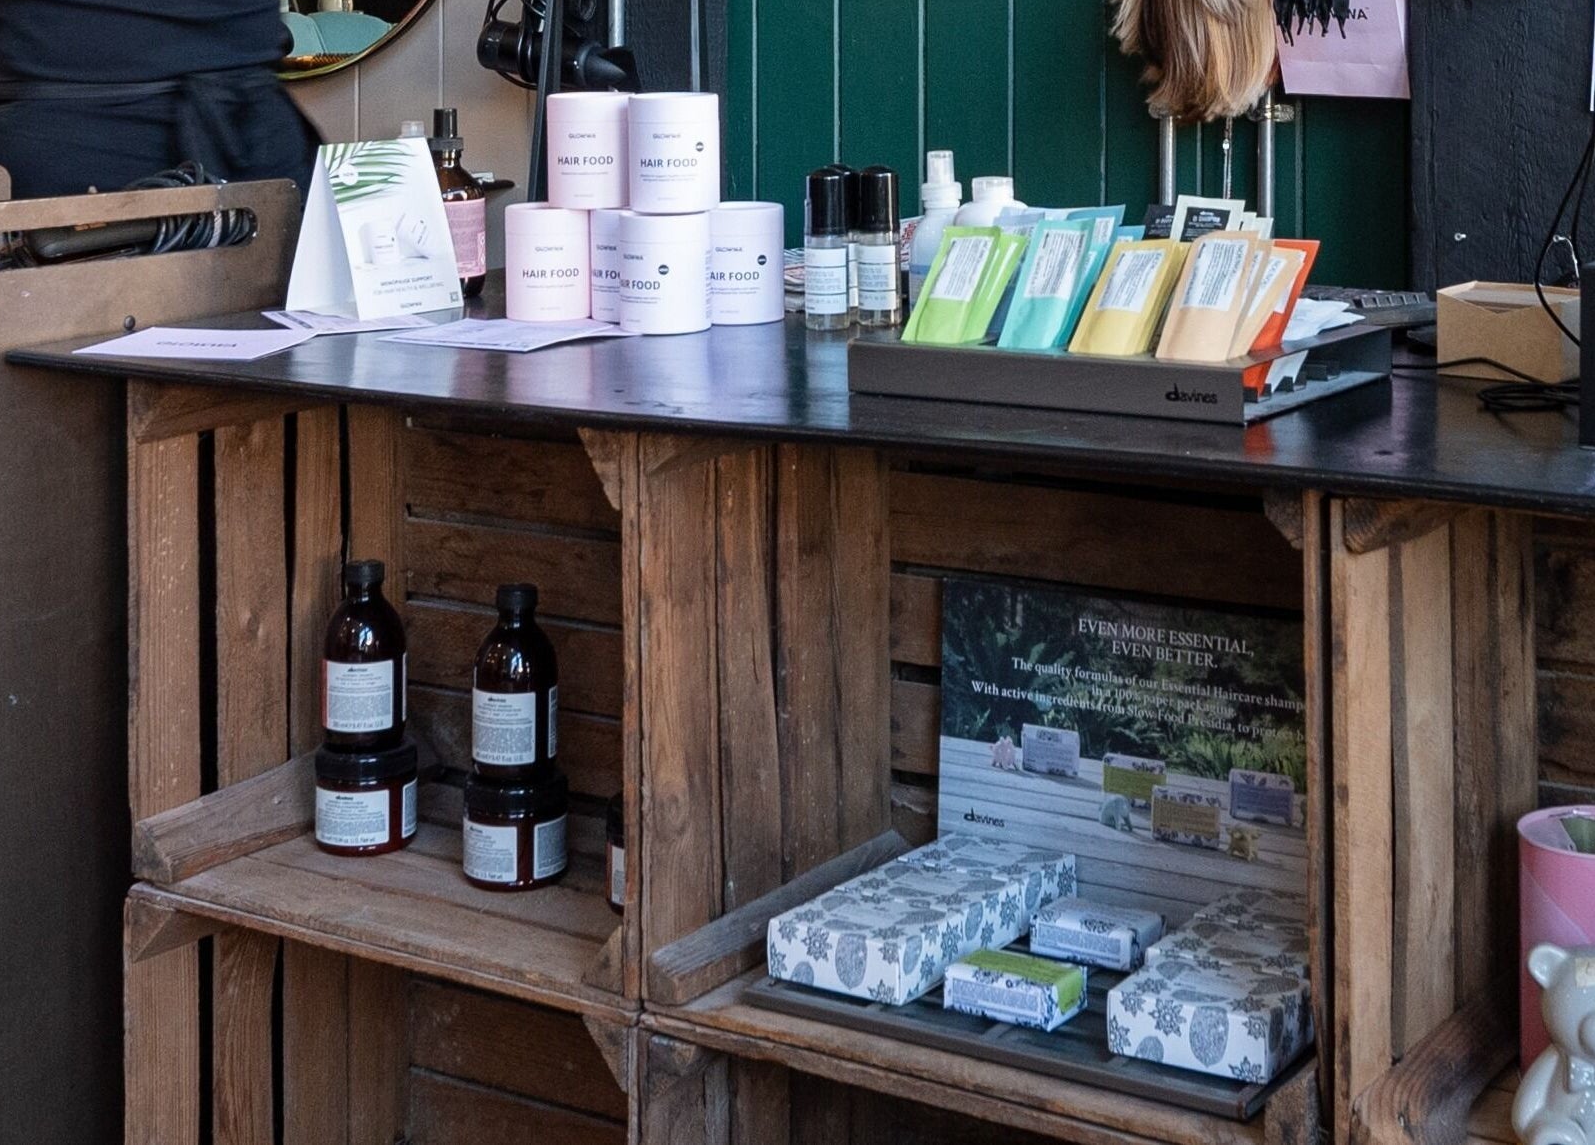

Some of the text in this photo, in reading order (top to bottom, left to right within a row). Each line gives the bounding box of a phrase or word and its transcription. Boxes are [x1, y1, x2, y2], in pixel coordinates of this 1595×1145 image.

[557, 155, 614, 167] HAIR FOOD
[640, 158, 698, 168] HAIR FOOD
[522, 267, 580, 279] HAIR FOOD
[709, 271, 760, 281] AIR FOOD
[632, 279, 661, 291] FOOD
[1165, 382, 1218, 405] davines
[1078, 618, 1255, 657] EVEN MORE ESSENTIAL,
[1112, 640, 1219, 669] EVEN BETTER.
[1011, 656, 1032, 671] The
[1035, 661, 1072, 680] quality
[1075, 666, 1123, 685] formulas
[1125, 674, 1137, 686] of
[1139, 677, 1159, 688] our
[1162, 679, 1211, 698] Essential
[1213, 686, 1263, 705] Haircare
[971, 679, 1000, 696] With
[1001, 687, 1034, 701] active
[1036, 691, 1096, 711] ingredients
[1096, 701, 1126, 715] from
[1127, 704, 1154, 719] Slow
[1157, 709, 1185, 724] Food
[1238, 723, 1250, 734] to
[1143, 693, 1176, 708] paper
[963, 806, 1005, 828] davines
